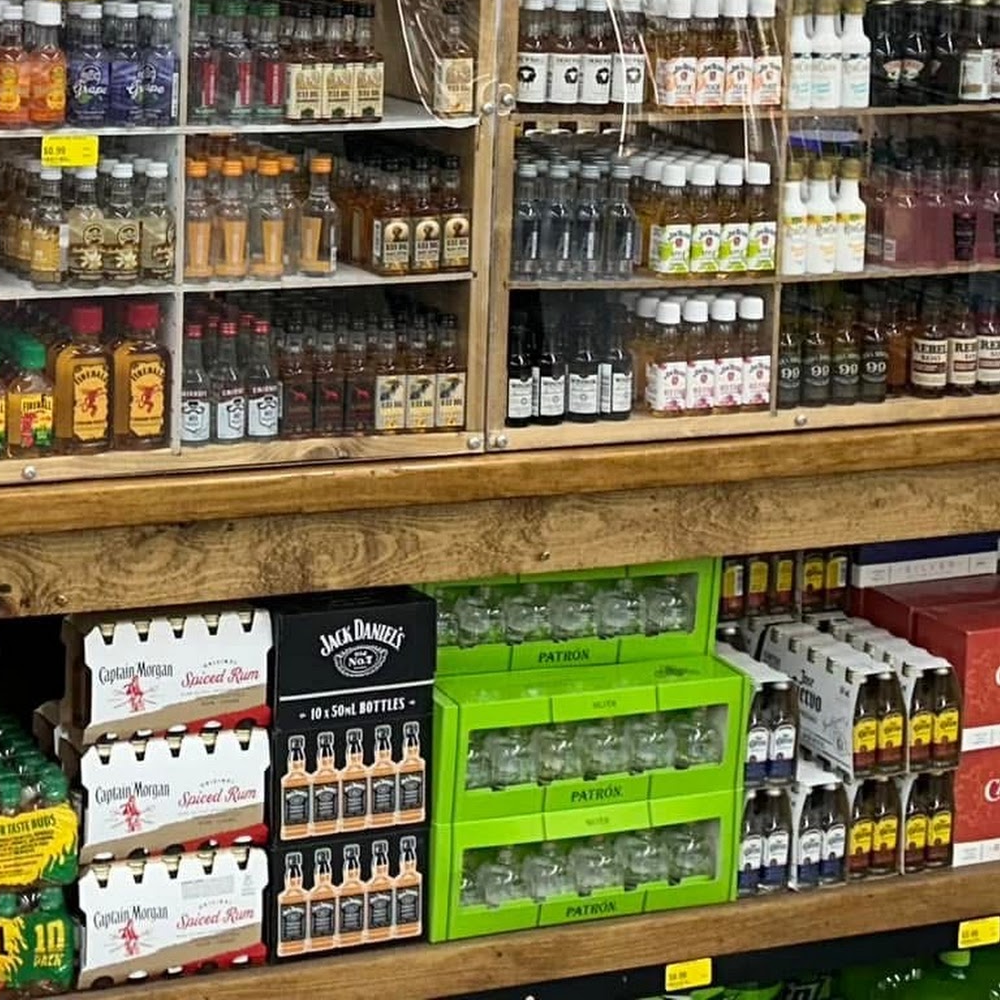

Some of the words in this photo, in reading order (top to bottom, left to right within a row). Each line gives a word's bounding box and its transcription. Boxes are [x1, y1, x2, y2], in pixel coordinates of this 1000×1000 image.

[913, 342, 947, 355] REBEL
[320, 624, 353, 657] JACK
[354, 618, 406, 652] DANIEL'S
[99, 666, 135, 685] Captain
[136, 661, 174, 679] Morgan
[181, 669, 223, 689] Spiced
[224, 667, 260, 684] Rum
[310, 708, 322, 721] 10
[359, 698, 406, 716] BOTTLES
[95, 786, 132, 805] Captain
[132, 781, 170, 799] Morgan
[178, 790, 219, 807] Spiced
[221, 787, 257, 804] Rum
[7, 817, 32, 835] TASTE
[93, 910, 130, 929] Captain
[131, 904, 168, 922] Morgan
[176, 911, 218, 929] Spiced
[219, 907, 255, 924] Rum
[34, 919, 65, 953] 10
[33, 951, 65, 967] PACK
